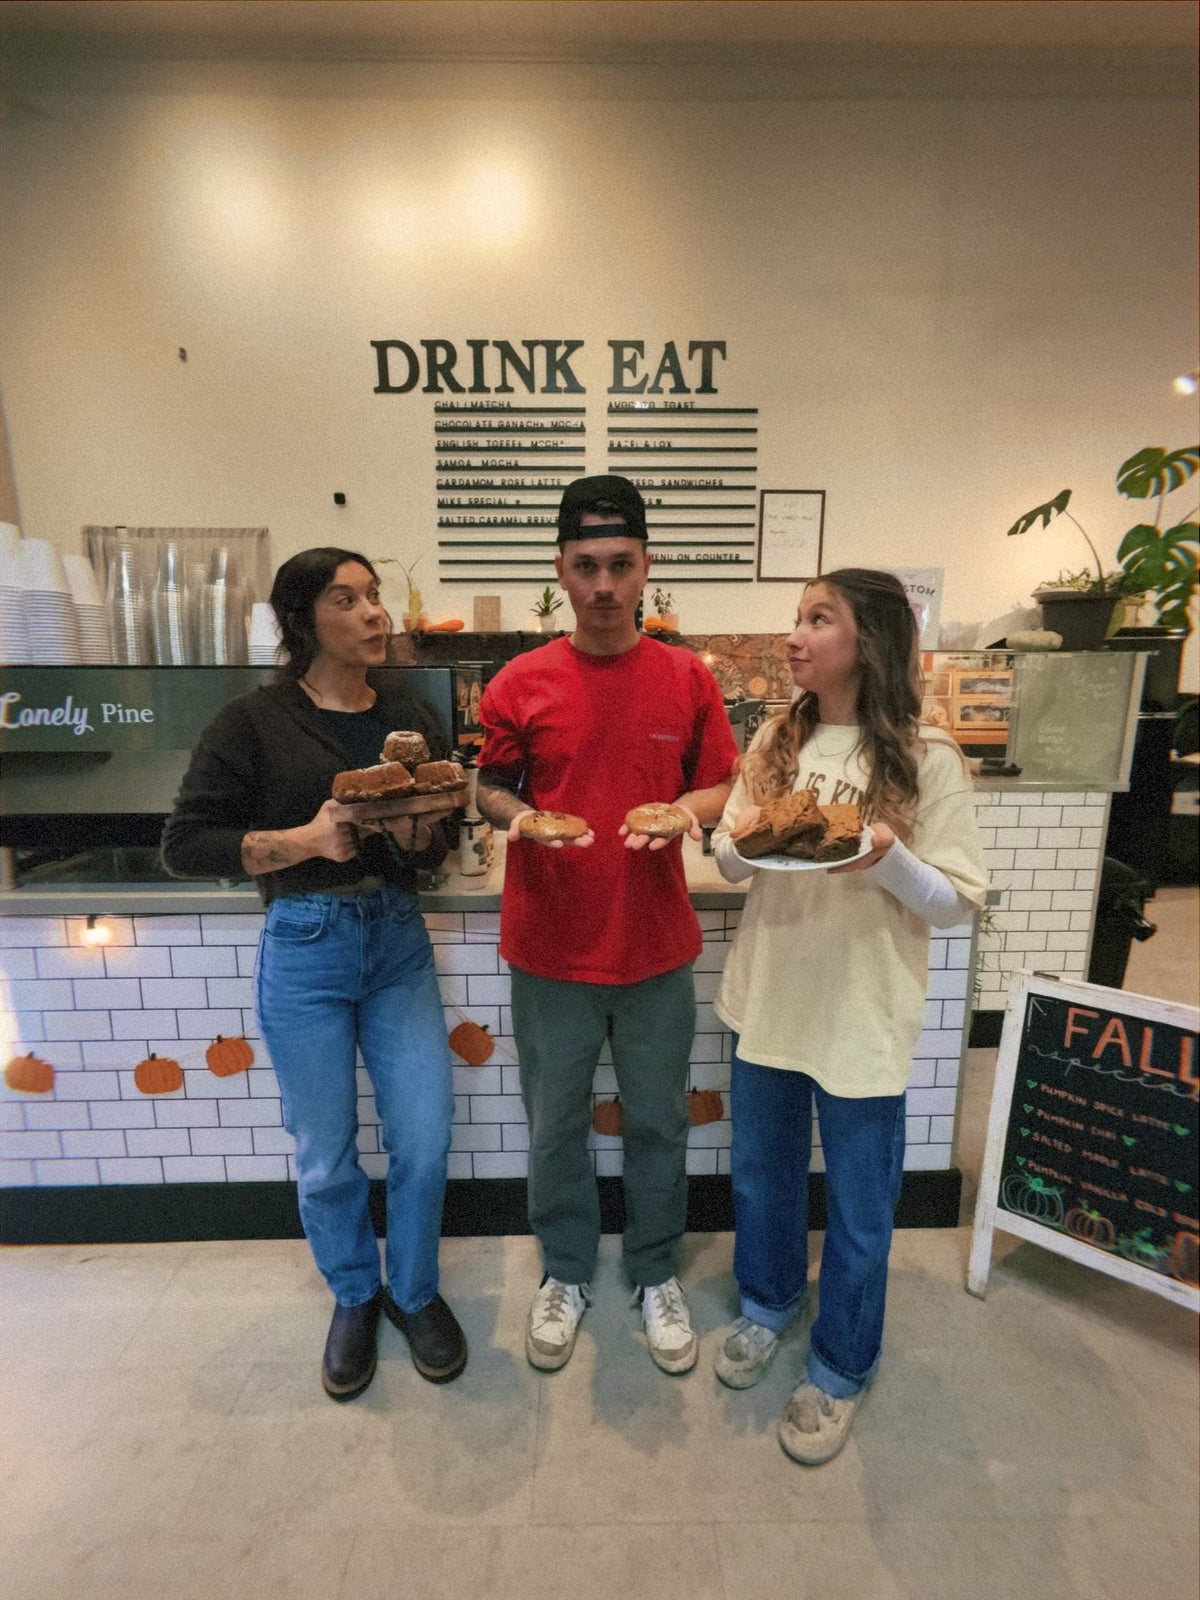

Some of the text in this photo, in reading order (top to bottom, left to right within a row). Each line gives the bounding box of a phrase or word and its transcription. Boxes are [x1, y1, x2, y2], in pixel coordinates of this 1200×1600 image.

[370, 339, 586, 393] DRINK
[607, 340, 727, 394] EAT
[435, 400, 459, 409] CHAI
[470, 400, 512, 409] MATCHA
[663, 400, 696, 409] TOAST
[435, 420, 585, 429] CHOCOLATE GANACHE MOCHA
[436, 439, 479, 448] ENGLISH
[486, 439, 523, 448] TOFFEE
[653, 440, 672, 448] LOX
[437, 459, 520, 467] SAMOA MOCHA
[436, 478, 561, 486] CARDAMOM ROSE LATTE
[661, 478, 724, 487] SANDWICHES
[437, 497, 507, 505] MIKE SPECIAL
[439, 516, 476, 524] SALTED
[479, 516, 522, 524] CARAMEL
[677, 553, 690, 561] ON
[695, 553, 741, 561] COUNTER
[0, 692, 155, 736] Lonely Pine
[1064, 1007, 1200, 1087] FALL
[1028, 1045, 1200, 1104] specia
[1041, 1083, 1087, 1106] PUMPKIN
[1032, 1132, 1072, 1153] SALTED
